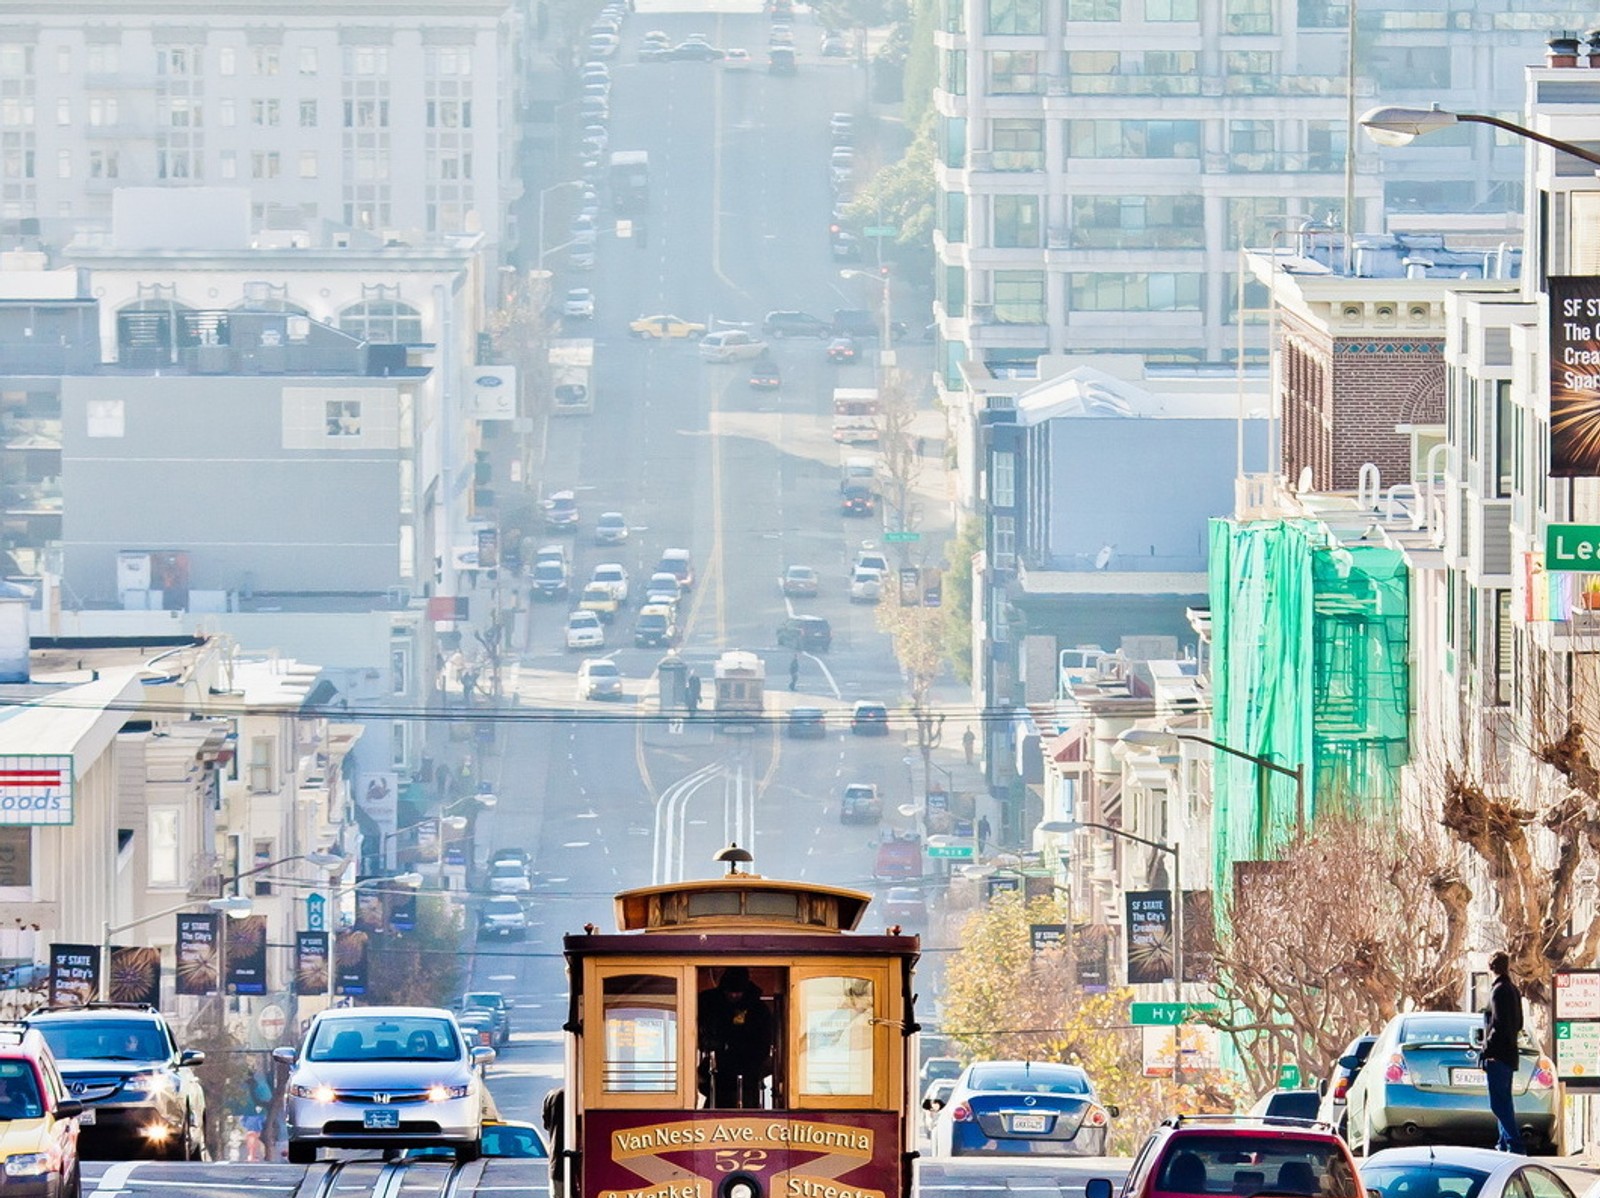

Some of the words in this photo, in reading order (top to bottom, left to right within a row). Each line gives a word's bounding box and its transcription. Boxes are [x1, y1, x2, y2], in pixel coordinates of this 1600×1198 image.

[1563, 298, 1583, 317] SF
[1563, 322, 1591, 341] The
[1556, 535, 1600, 560] Le
[0, 787, 61, 811] oods
[1131, 901, 1142, 910] SF
[1143, 900, 1164, 910] STATE
[310, 901, 321, 931] HO
[56, 955, 66, 965] SF
[67, 955, 92, 966] STATE
[1559, 1026, 1569, 1038] 2
[765, 1123, 870, 1151] California
[715, 1149, 767, 1173] 52
